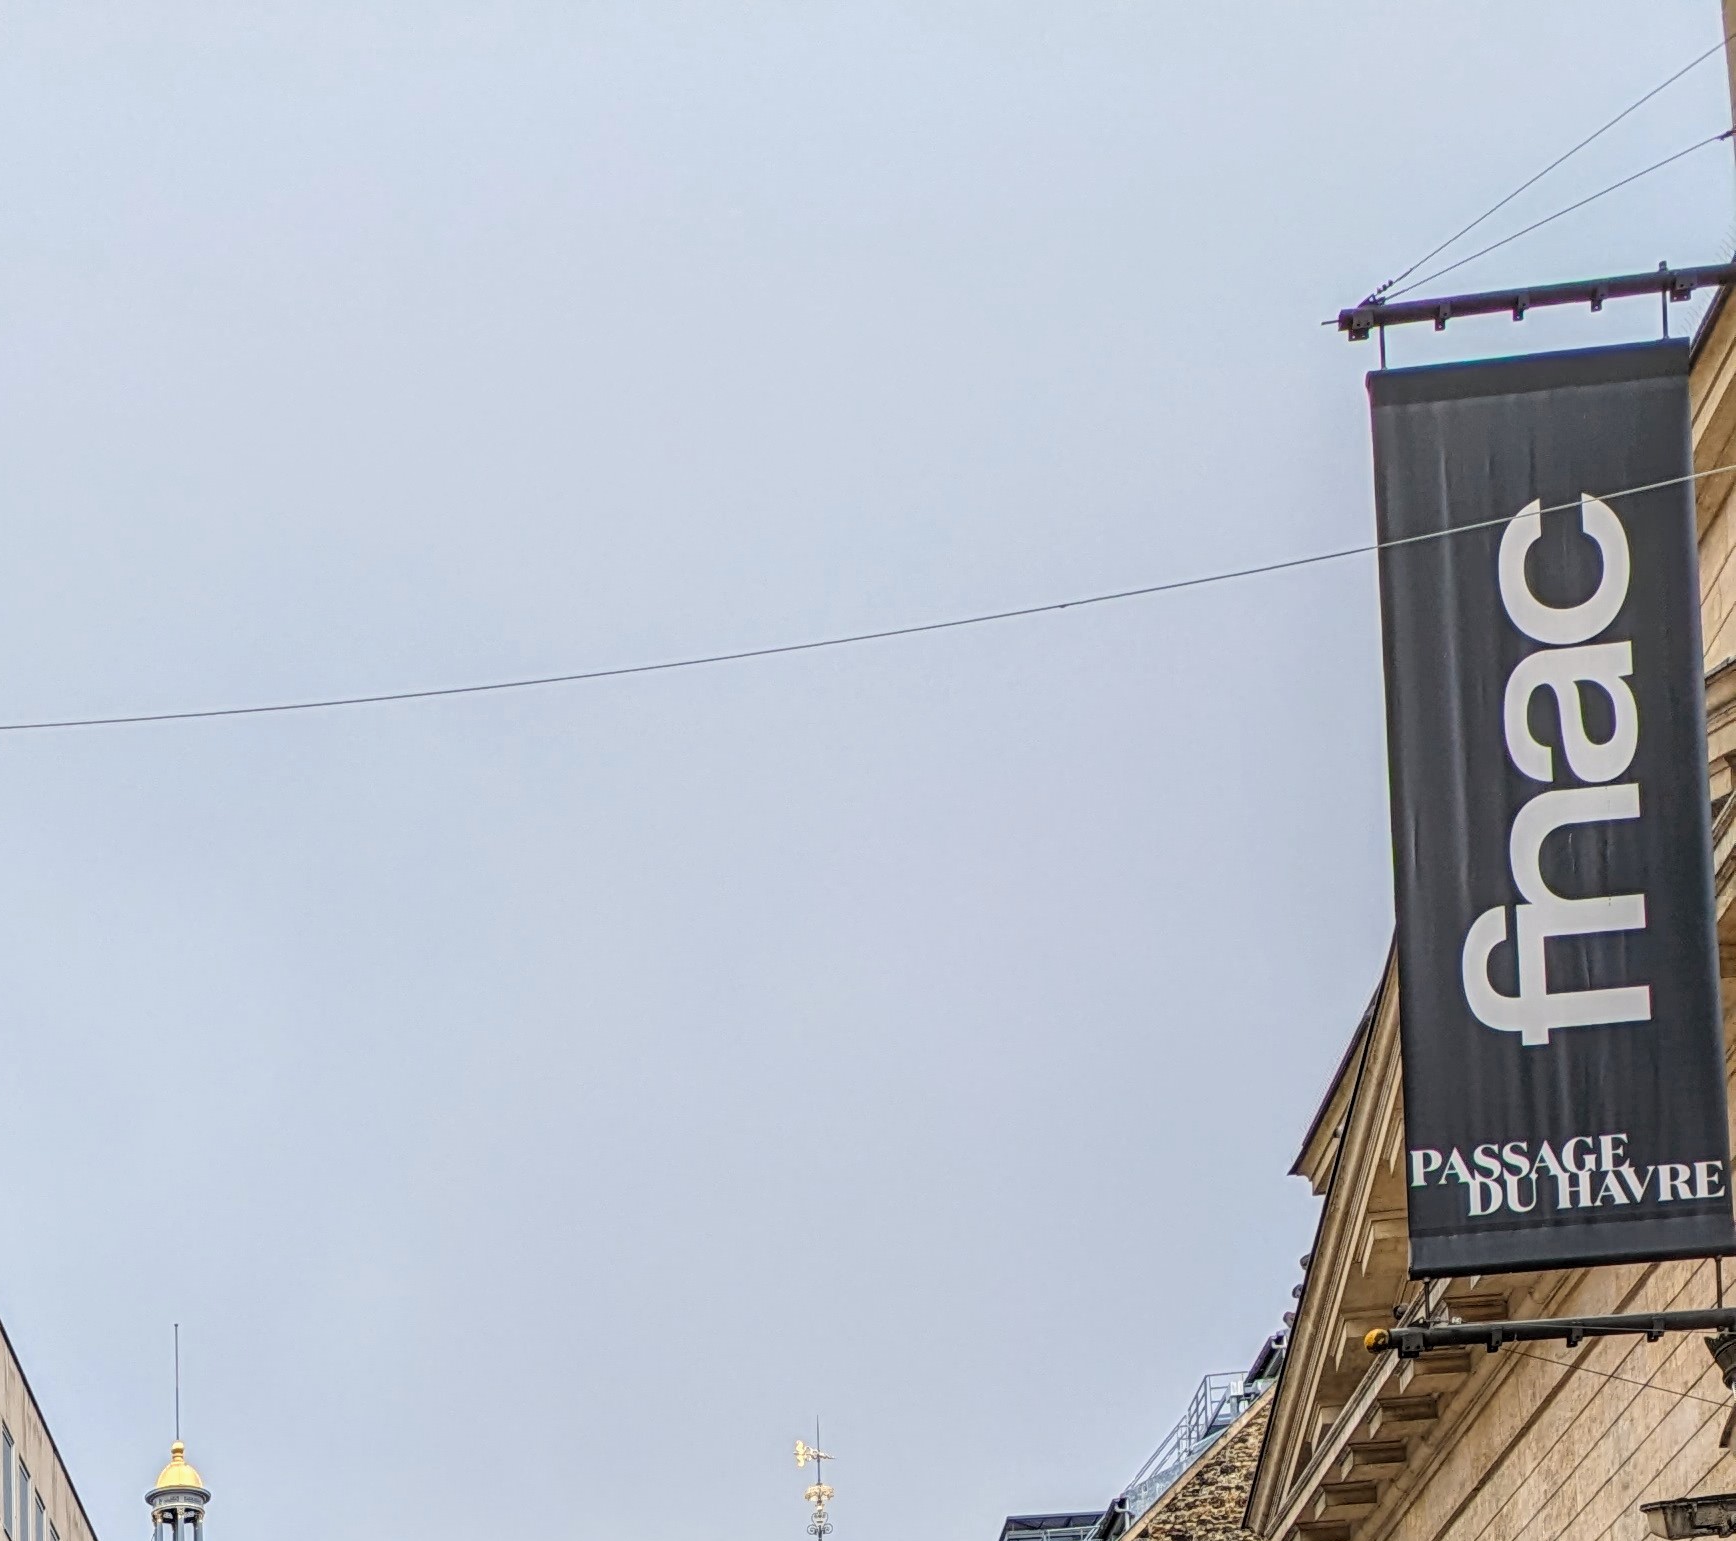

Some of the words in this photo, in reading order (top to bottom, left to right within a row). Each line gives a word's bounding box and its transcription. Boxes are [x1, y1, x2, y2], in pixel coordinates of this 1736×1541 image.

[1462, 493, 1652, 1045] fnac
[1410, 1133, 1631, 1187] PASSAGE
[1467, 1169, 1539, 1217] DU
[1555, 1160, 1726, 1210] HAVRE
